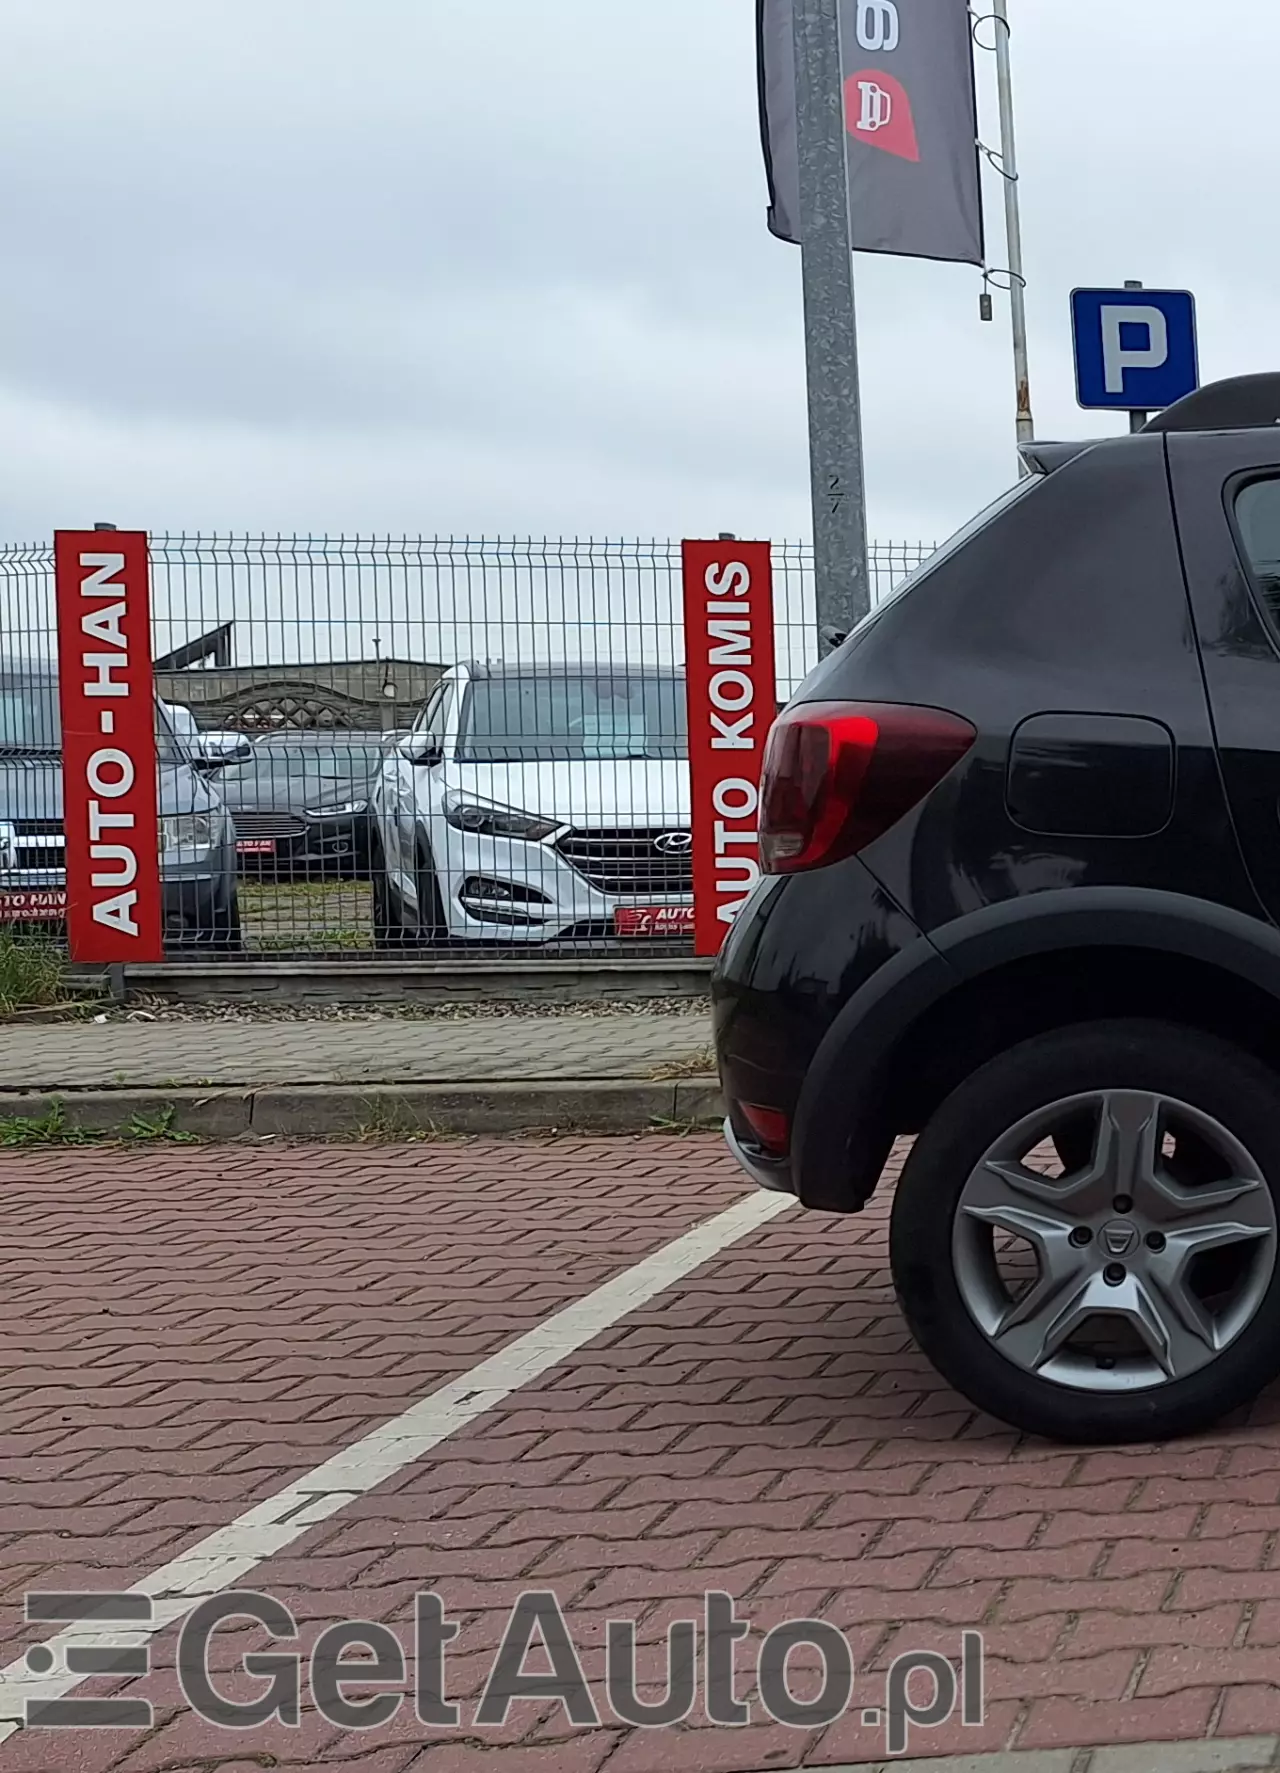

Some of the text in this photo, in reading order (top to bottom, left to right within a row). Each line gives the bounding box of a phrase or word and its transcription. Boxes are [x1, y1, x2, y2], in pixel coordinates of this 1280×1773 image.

[1100, 304, 1168, 393] P
[704, 560, 754, 750] KOMIS
[0, 895, 26, 907] TO
